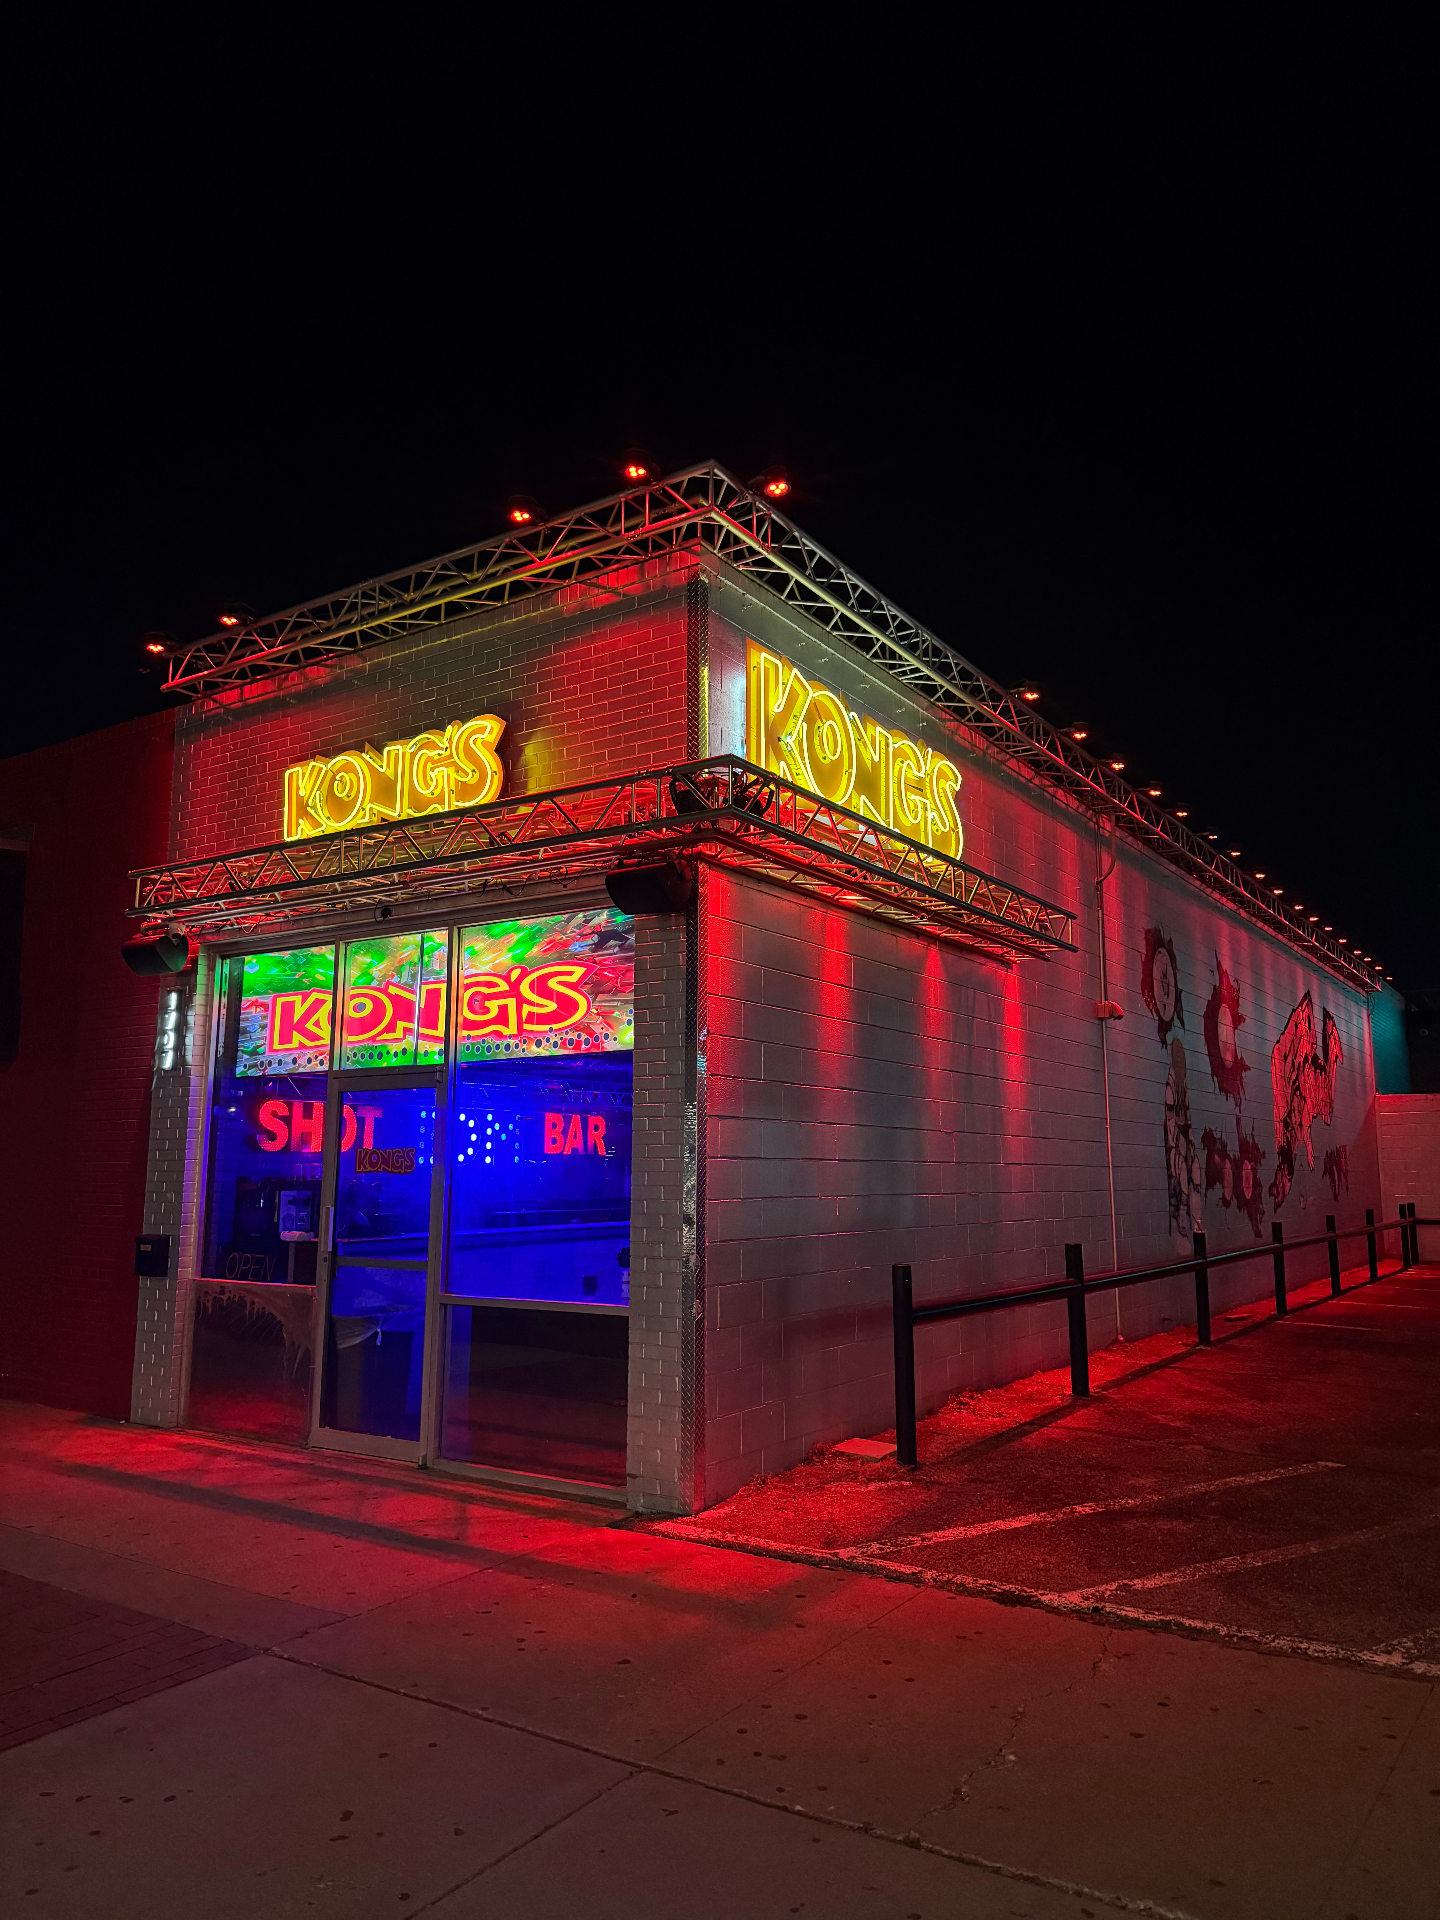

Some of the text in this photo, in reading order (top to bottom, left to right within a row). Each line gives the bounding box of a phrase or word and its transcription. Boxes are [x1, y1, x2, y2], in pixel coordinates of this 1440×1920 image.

[283, 714, 507, 842] KONG'S
[746, 638, 964, 864] KONG'S
[267, 962, 599, 1055] KONG'S
[355, 1147, 416, 1175] KONG'S
[544, 1112, 606, 1156] BAR
[226, 1252, 277, 1281] OPEN
